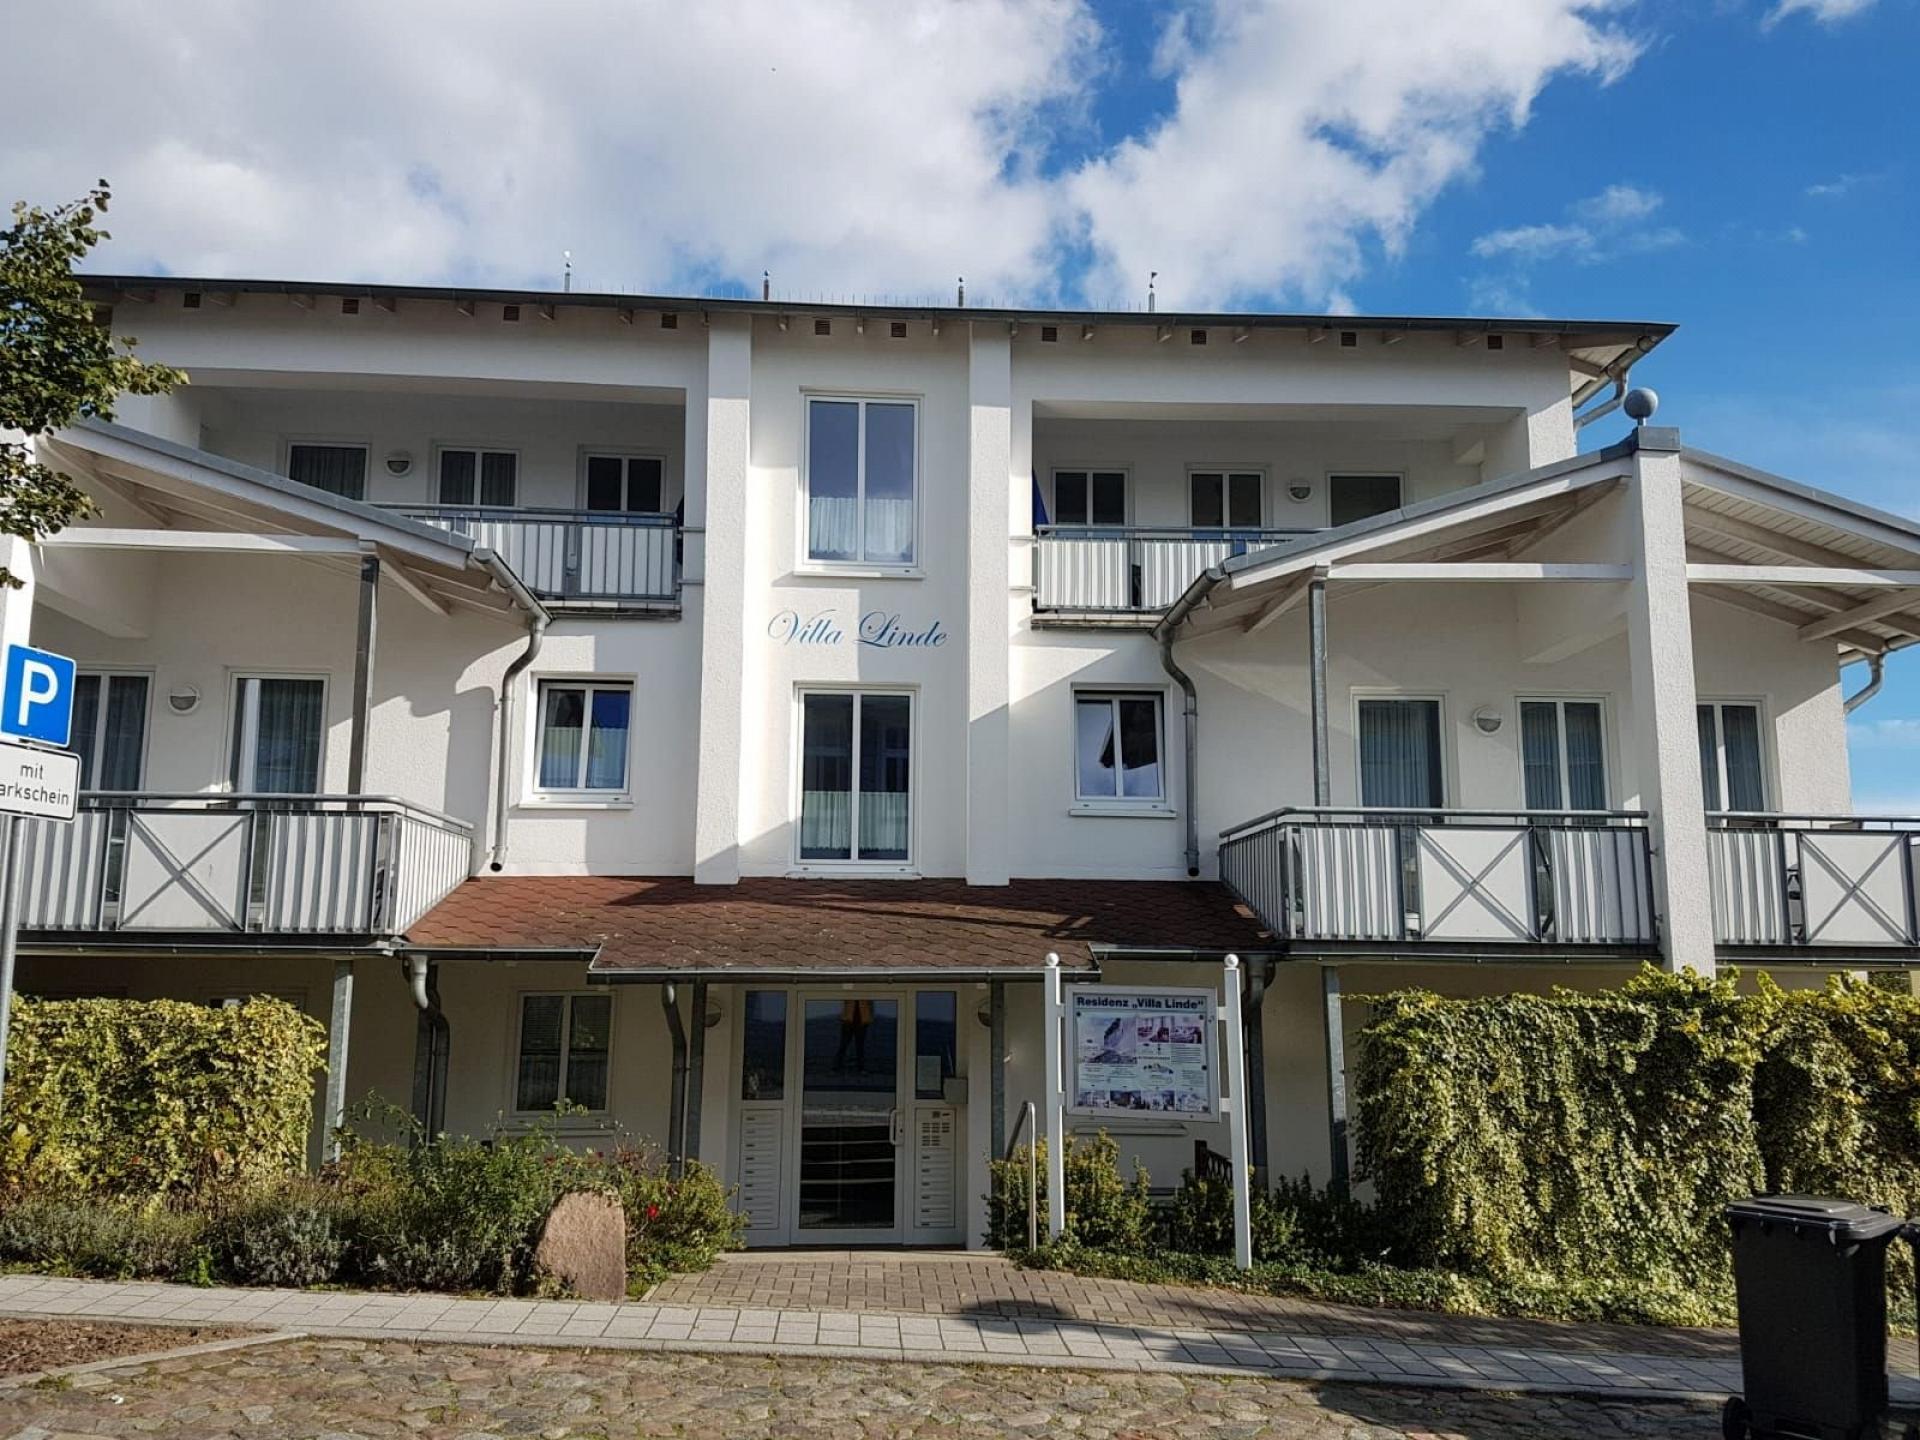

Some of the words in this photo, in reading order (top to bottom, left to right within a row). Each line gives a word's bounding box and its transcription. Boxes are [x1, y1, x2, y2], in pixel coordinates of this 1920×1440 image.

[768, 609, 843, 646] Villa
[854, 611, 948, 648] Linde
[18, 659, 59, 726] P
[20, 763, 44, 780] mit
[0, 782, 70, 806] arkschein
[1077, 996, 1129, 1007] Residenz
